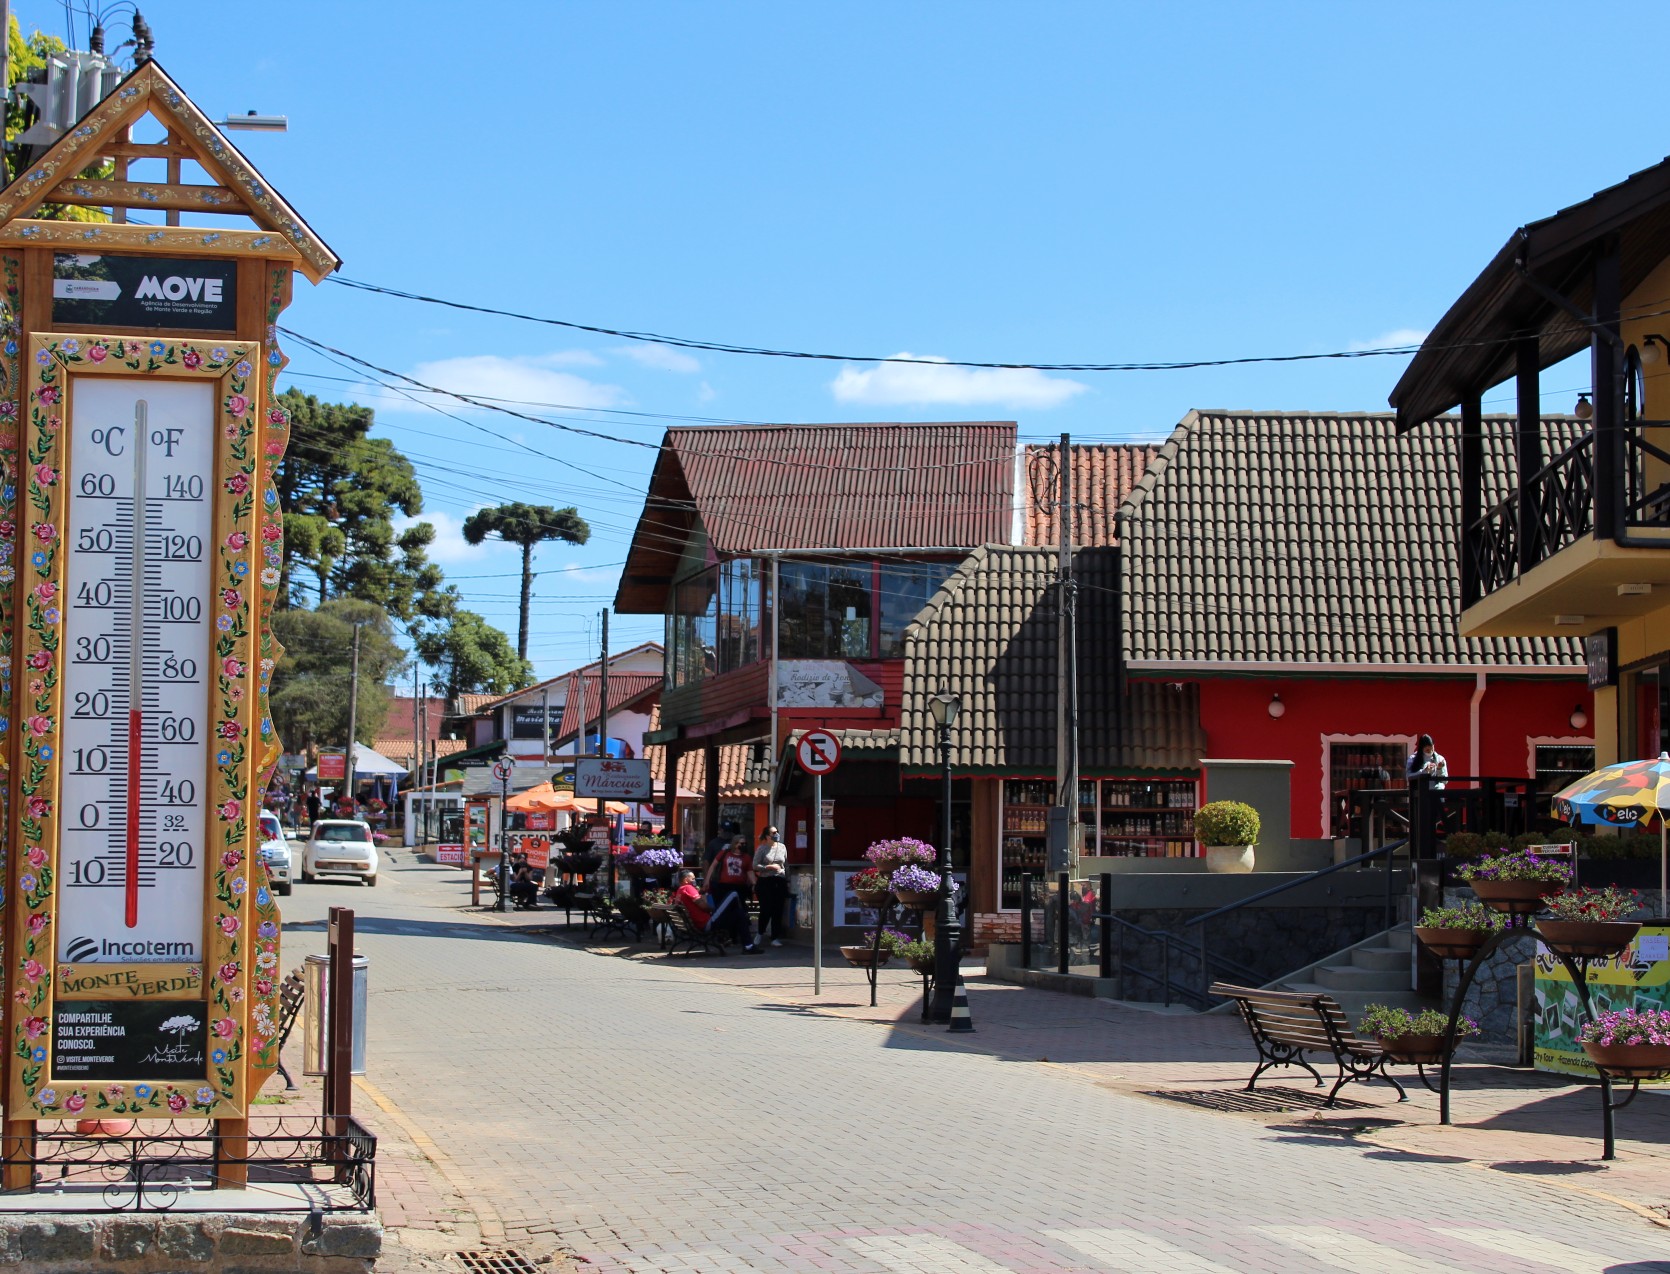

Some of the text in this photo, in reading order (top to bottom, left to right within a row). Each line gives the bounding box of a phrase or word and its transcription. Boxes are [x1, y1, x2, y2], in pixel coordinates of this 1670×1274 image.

[134, 275, 223, 302] MOVE
[81, 473, 115, 496] 60
[163, 474, 203, 499] 140
[78, 527, 113, 551] 50
[161, 535, 202, 560] 120
[77, 581, 112, 605] 40
[161, 596, 201, 620] 100
[76, 637, 110, 661] 30
[162, 654, 197, 679] 80
[822, 673, 831, 681] de
[834, 673, 850, 682] Fon
[74, 692, 109, 717] 20
[161, 717, 195, 741] 60
[73, 748, 107, 772] 10
[811, 739, 826, 765] E
[160, 779, 195, 804] 40
[80, 804, 99, 828] 0
[164, 815, 184, 828] 32
[1617, 808, 1638, 819] elo
[159, 842, 193, 866] 20
[102, 938, 194, 956] Incoterm
[62, 971, 139, 993] MONTE
[127, 976, 200, 996] VERDE
[58, 1013, 112, 1023] COMPARTILHE
[58, 1024, 125, 1036] SUA EXPERIÊNCIA
[57, 1039, 95, 1049] CONOSCO.
[154, 1044, 188, 1054] Visite
[1543, 1053, 1554, 1063] Tour
[1581, 1058, 1596, 1069] Esper
